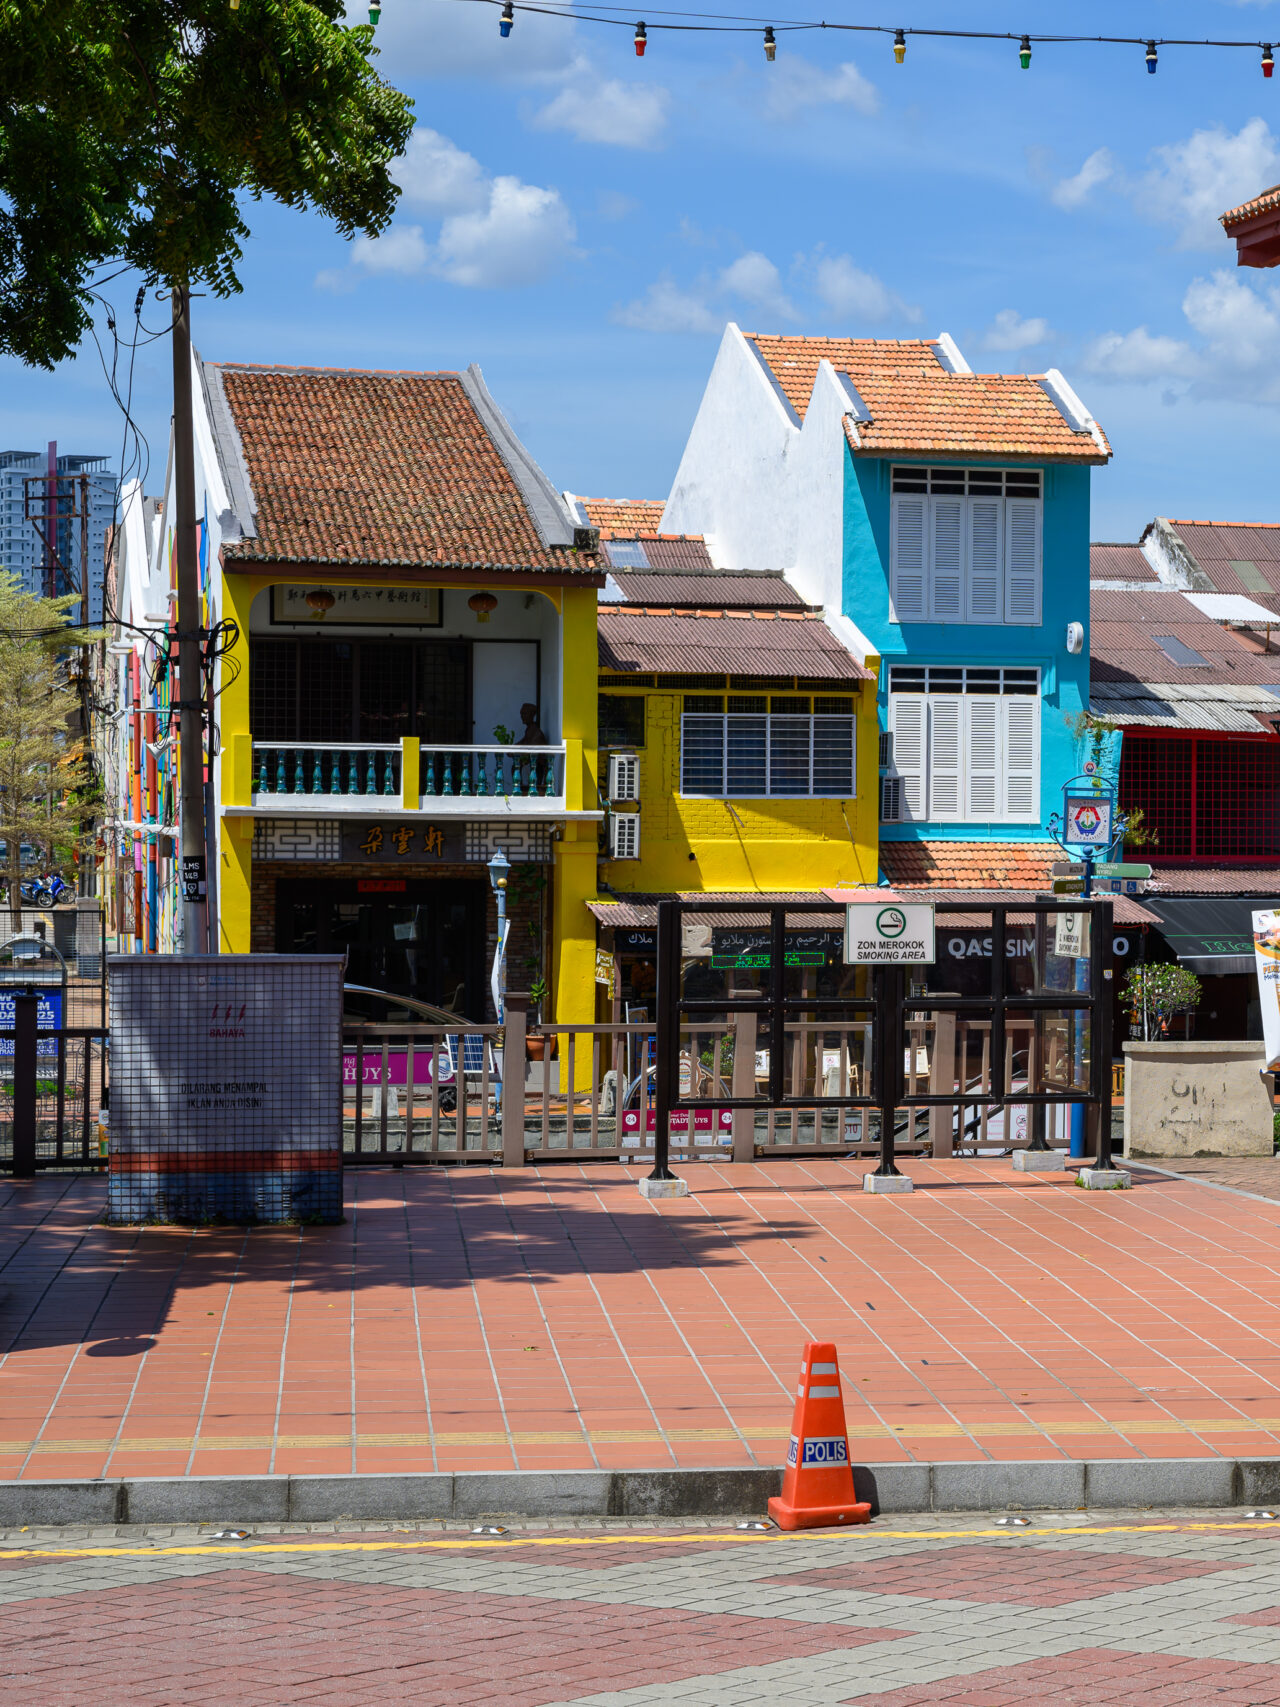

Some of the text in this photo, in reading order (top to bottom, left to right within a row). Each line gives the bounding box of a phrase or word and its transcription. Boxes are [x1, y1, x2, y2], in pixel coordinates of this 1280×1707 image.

[857, 941, 925, 950] ZON MEROKOK
[857, 950, 927, 961] SMOKING AREA
[210, 1028, 245, 1038] BAHAYA
[181, 1083, 269, 1094] DILARANG MENAMPAL
[626, 1115, 636, 1123] 24
[805, 1441, 847, 1462] POLIS
